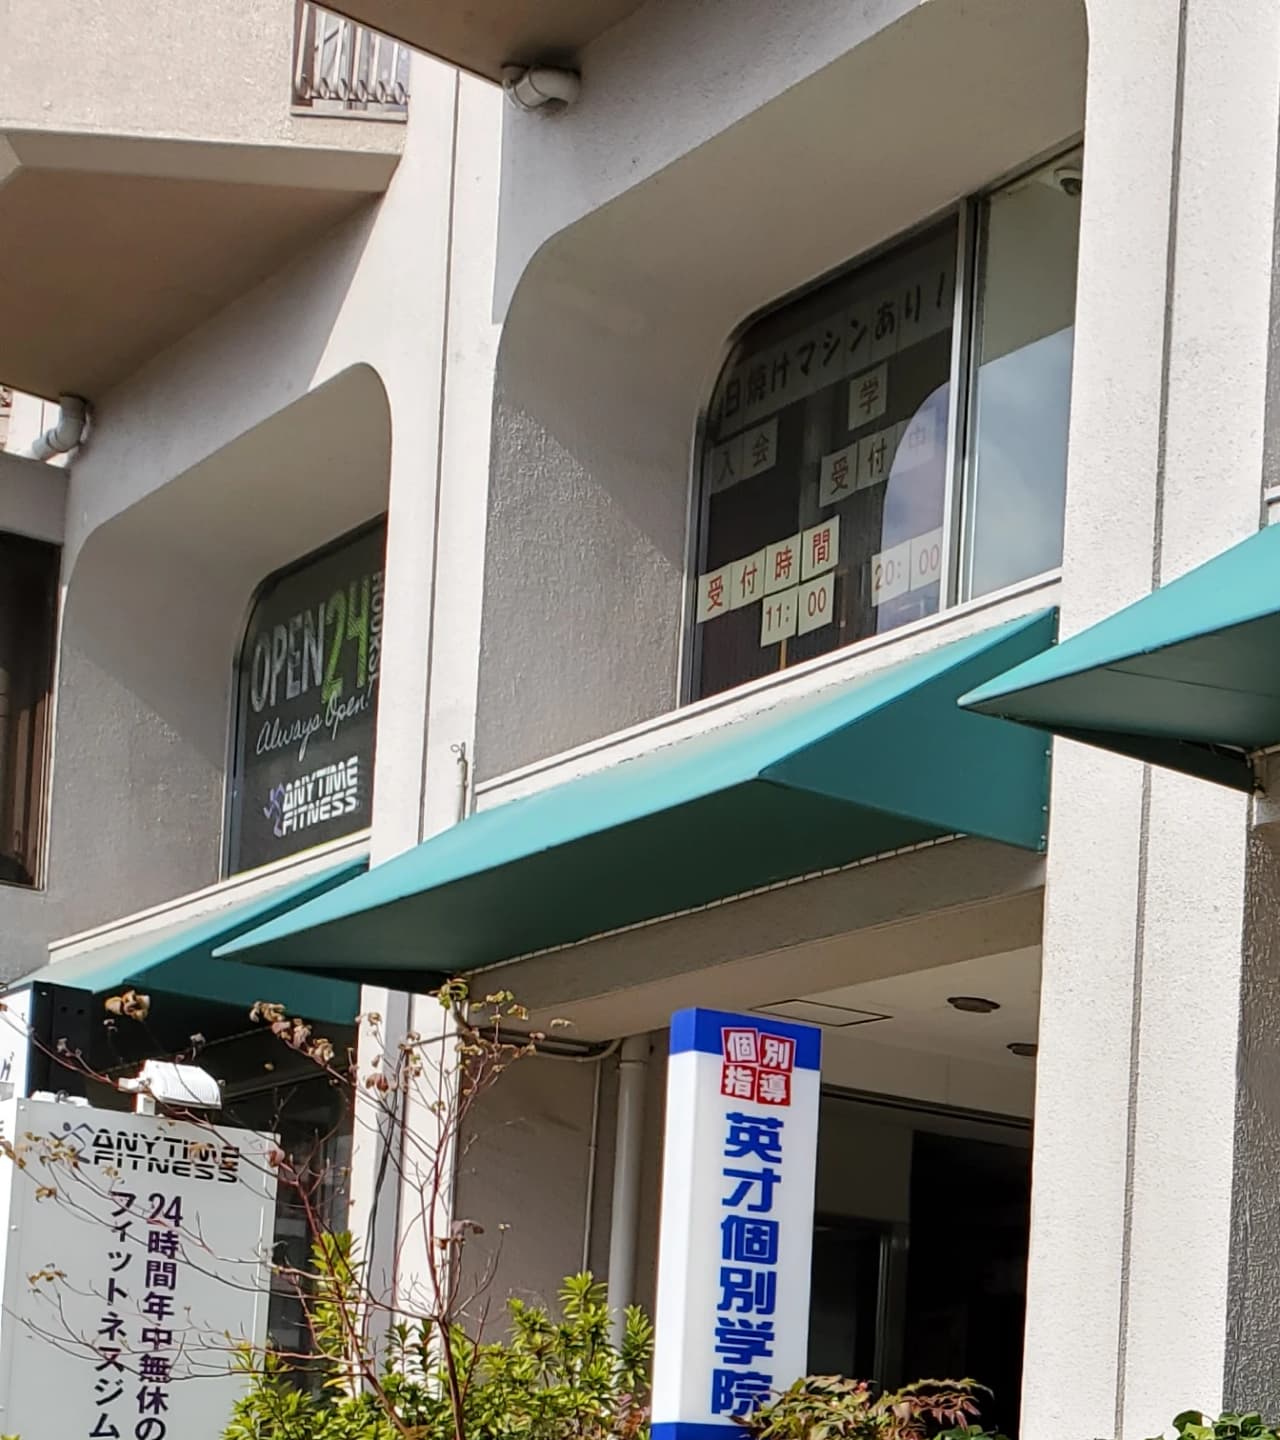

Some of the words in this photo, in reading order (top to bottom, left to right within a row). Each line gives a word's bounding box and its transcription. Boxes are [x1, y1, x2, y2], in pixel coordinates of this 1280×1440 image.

[858, 378, 880, 416] 学
[706, 527, 832, 613] 受付時間
[765, 588, 827, 633] 11:00
[251, 602, 325, 713] OPEN
[321, 576, 370, 704] 24
[256, 713, 323, 762] Always
[282, 756, 359, 809] ANYTIME
[281, 793, 358, 837] FITNESS
[727, 1031, 791, 1070] 個別
[725, 1067, 788, 1104] 指導
[92, 1128, 240, 1165] ANYTIME
[94, 1150, 240, 1183] FITNESS
[711, 1111, 785, 1416] 英才個別学院
[89, 1191, 138, 1440] フィットネスジム
